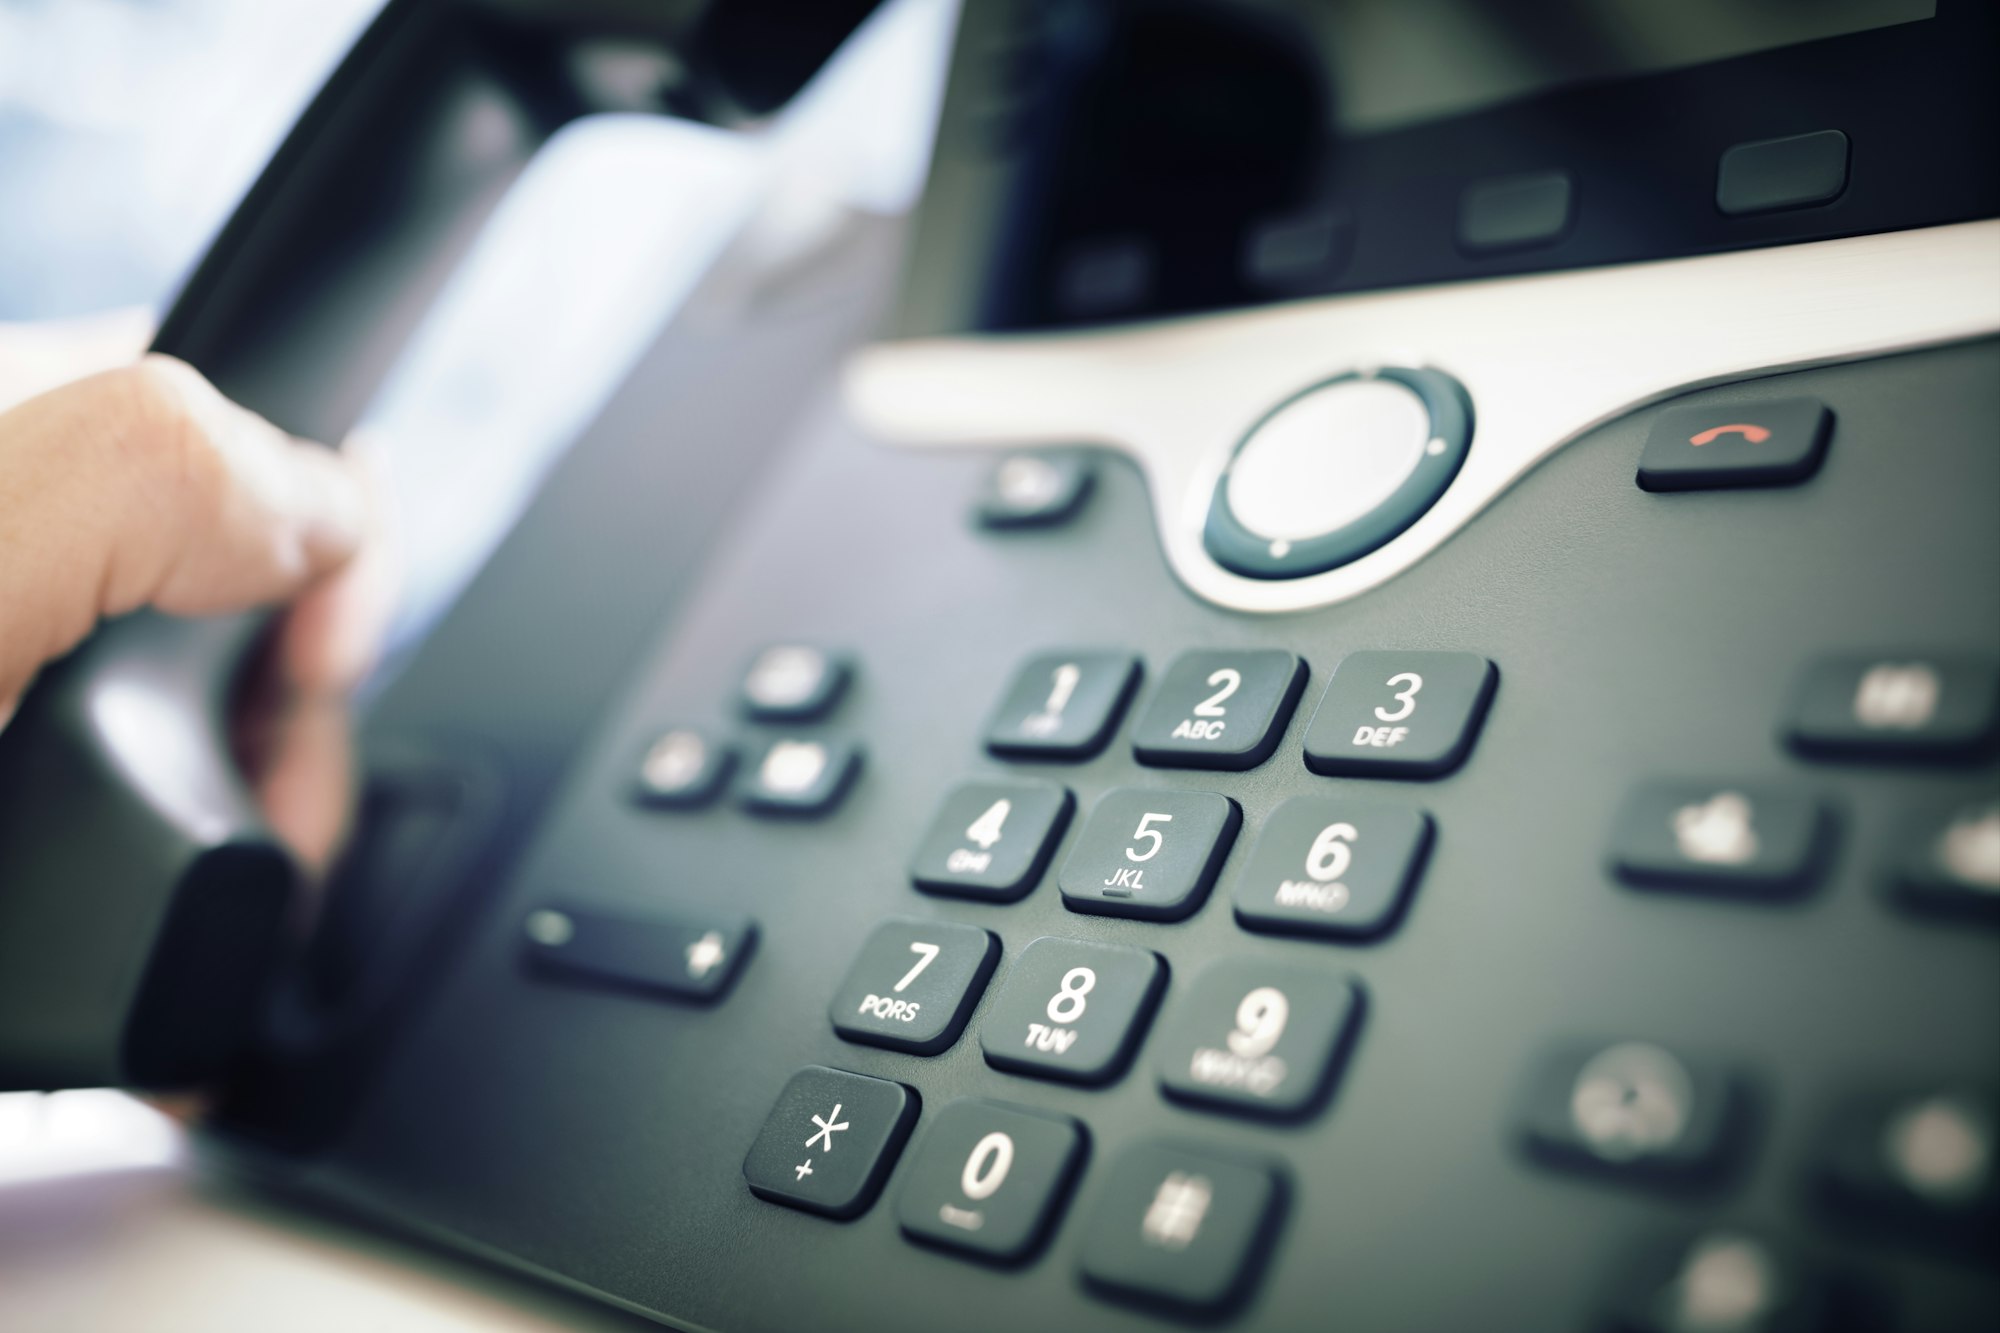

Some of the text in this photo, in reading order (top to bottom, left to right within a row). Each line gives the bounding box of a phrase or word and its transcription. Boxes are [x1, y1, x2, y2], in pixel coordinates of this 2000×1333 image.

[1045, 664, 1080, 714] 1
[1193, 668, 1241, 717] 2
[1374, 672, 1423, 722] 3
[1171, 719, 1226, 741] ABC
[1352, 725, 1409, 747] DEF
[965, 798, 1011, 849] 4
[1125, 812, 1173, 862] 5
[1305, 822, 1358, 882] 6
[1104, 868, 1144, 889] JKL
[893, 941, 940, 992] 7
[858, 993, 921, 1022] PQRS
[1046, 966, 1097, 1024] 8
[1024, 1023, 1077, 1054] TUV
[1227, 986, 1290, 1058] 9
[961, 1131, 1014, 1200] 0
